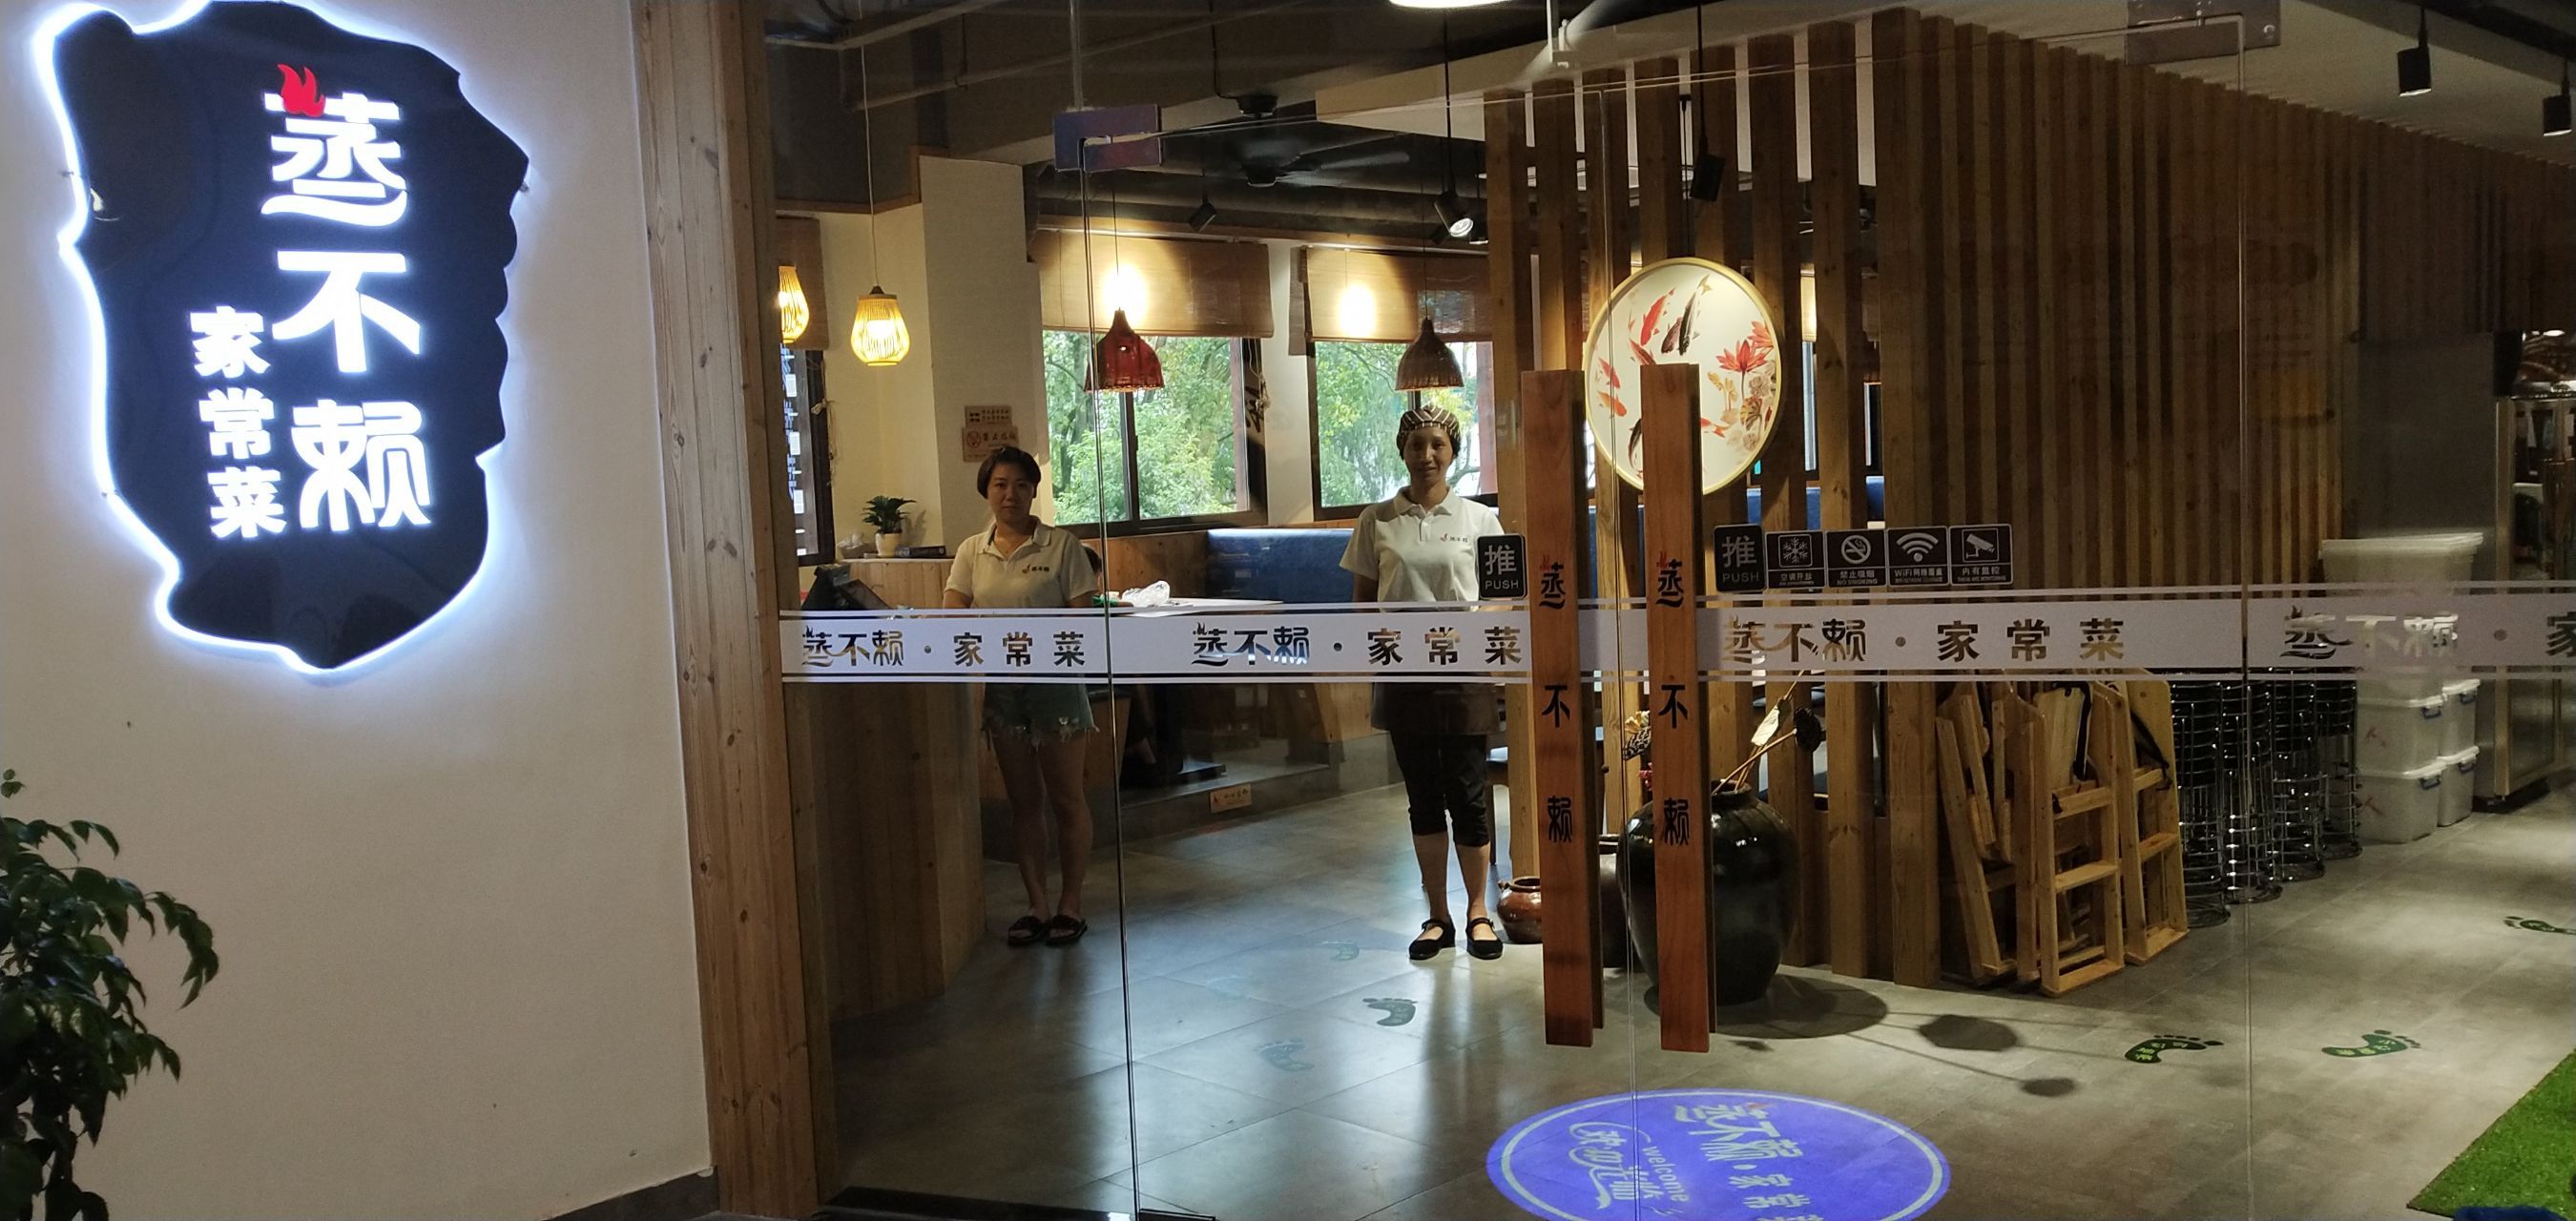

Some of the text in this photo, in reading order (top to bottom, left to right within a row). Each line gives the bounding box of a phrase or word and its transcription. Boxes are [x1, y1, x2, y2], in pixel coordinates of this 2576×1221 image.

[261, 64, 432, 532] 蒸不赖
[191, 305, 287, 540] 家常菜
[1485, 545, 1518, 576] 推
[1722, 535, 1758, 569] 推
[1839, 569, 1876, 579] 禁止吸烟
[1485, 580, 1519, 590] PUSH
[1722, 571, 1760, 583] PUSH
[1539, 554, 1573, 843] 蒸不赖
[1655, 552, 1691, 846] 蒸不赖
[1643, 1146, 1690, 1203] welcome
